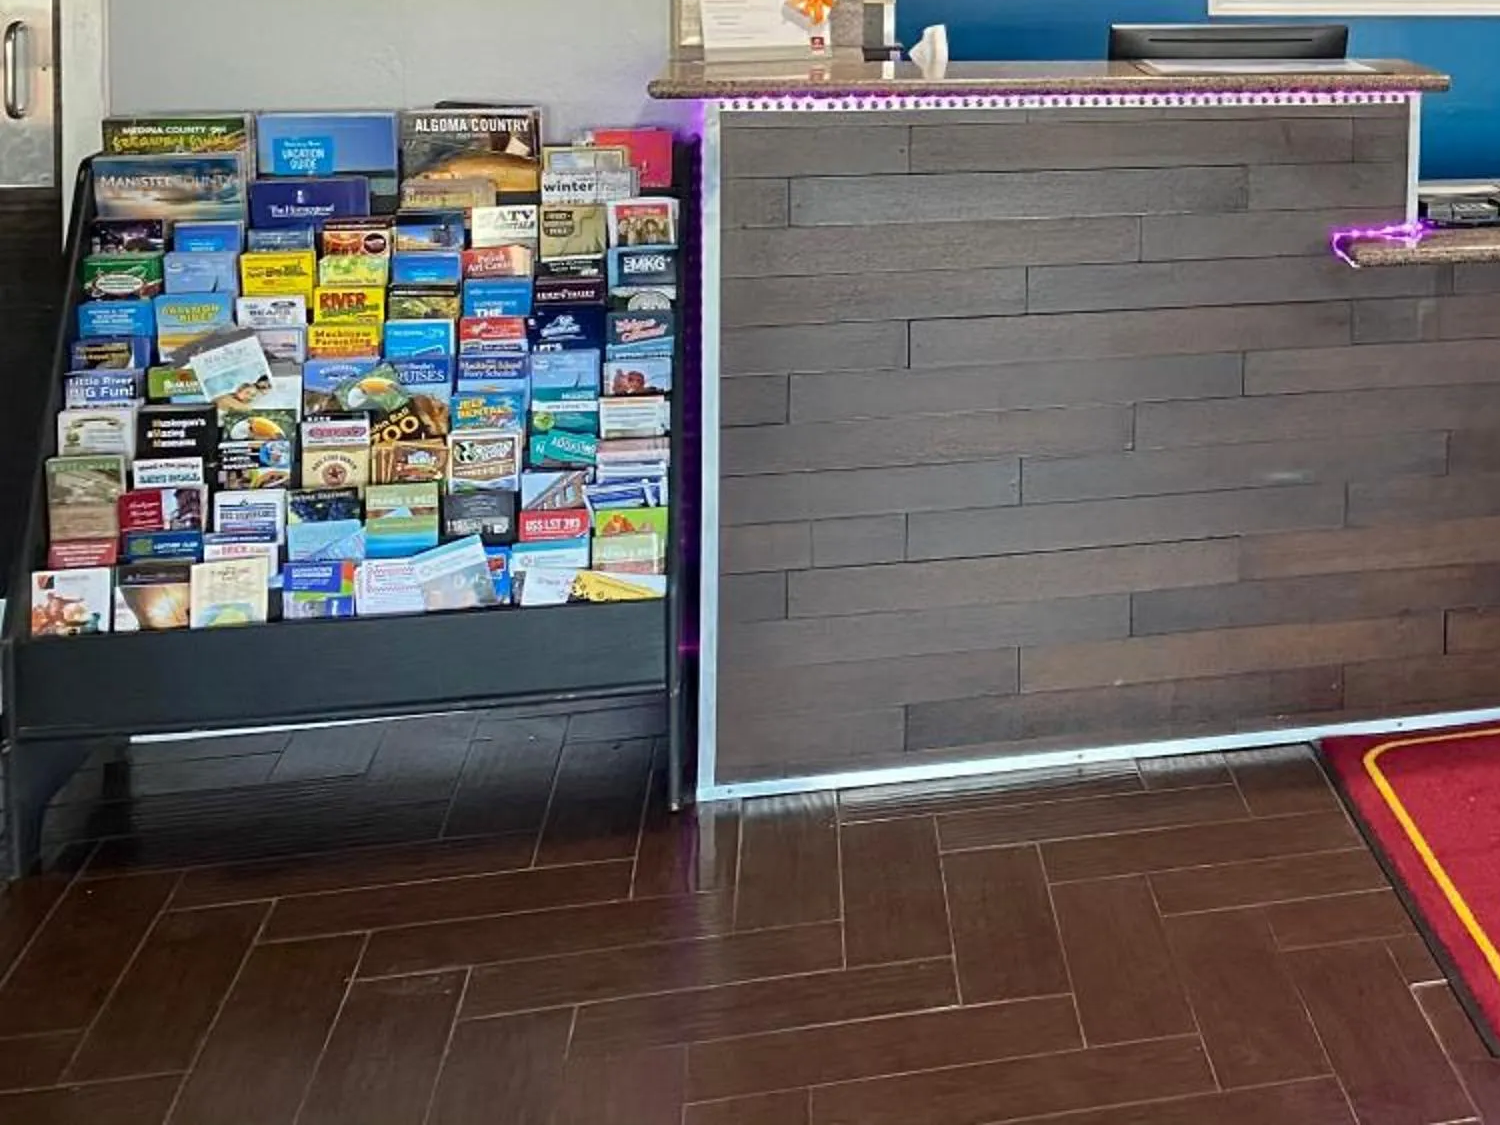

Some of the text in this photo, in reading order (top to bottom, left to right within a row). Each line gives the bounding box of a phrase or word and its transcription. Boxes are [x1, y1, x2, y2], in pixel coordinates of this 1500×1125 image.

[165, 126, 207, 134] COUNTY
[415, 118, 530, 132] ALGOMA COUNTRY
[281, 148, 325, 160] VACATION
[543, 180, 595, 194] winter
[498, 209, 535, 225] ATV
[319, 292, 369, 308] RIVER
[68, 376, 134, 387] Little River
[101, 385, 136, 398] Fun!
